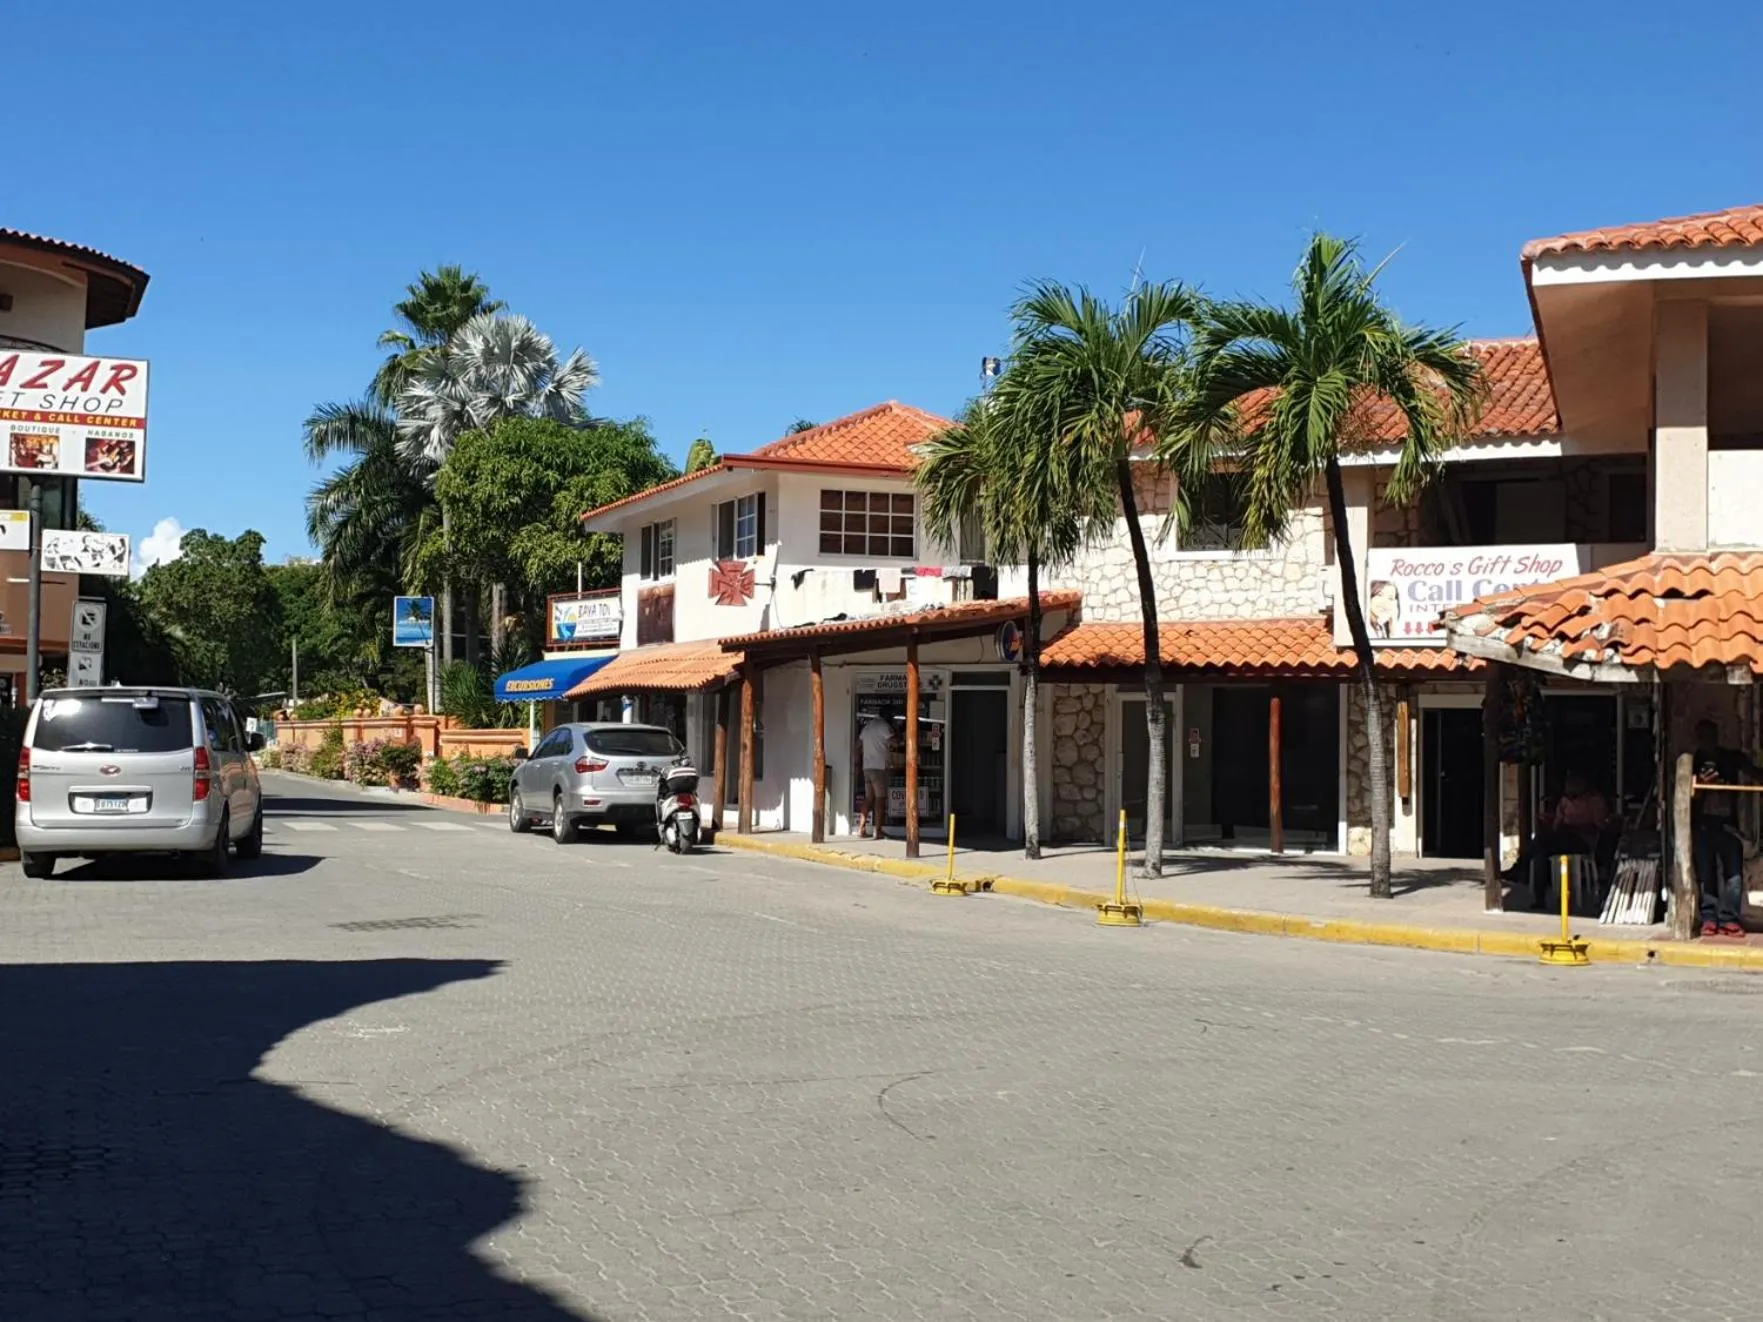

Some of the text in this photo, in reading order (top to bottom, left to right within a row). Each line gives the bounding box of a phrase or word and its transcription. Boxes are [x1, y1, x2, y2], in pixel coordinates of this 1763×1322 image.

[39, 393, 124, 413] SHOP
[34, 413, 42, 422] &
[48, 413, 80, 424] CALL
[86, 416, 137, 428] CENTER
[10, 424, 135, 439] BOUTIQUE HABANOS
[1467, 555, 1512, 575] Gift
[1513, 553, 1563, 577] Shop
[1407, 579, 1463, 602] Call
